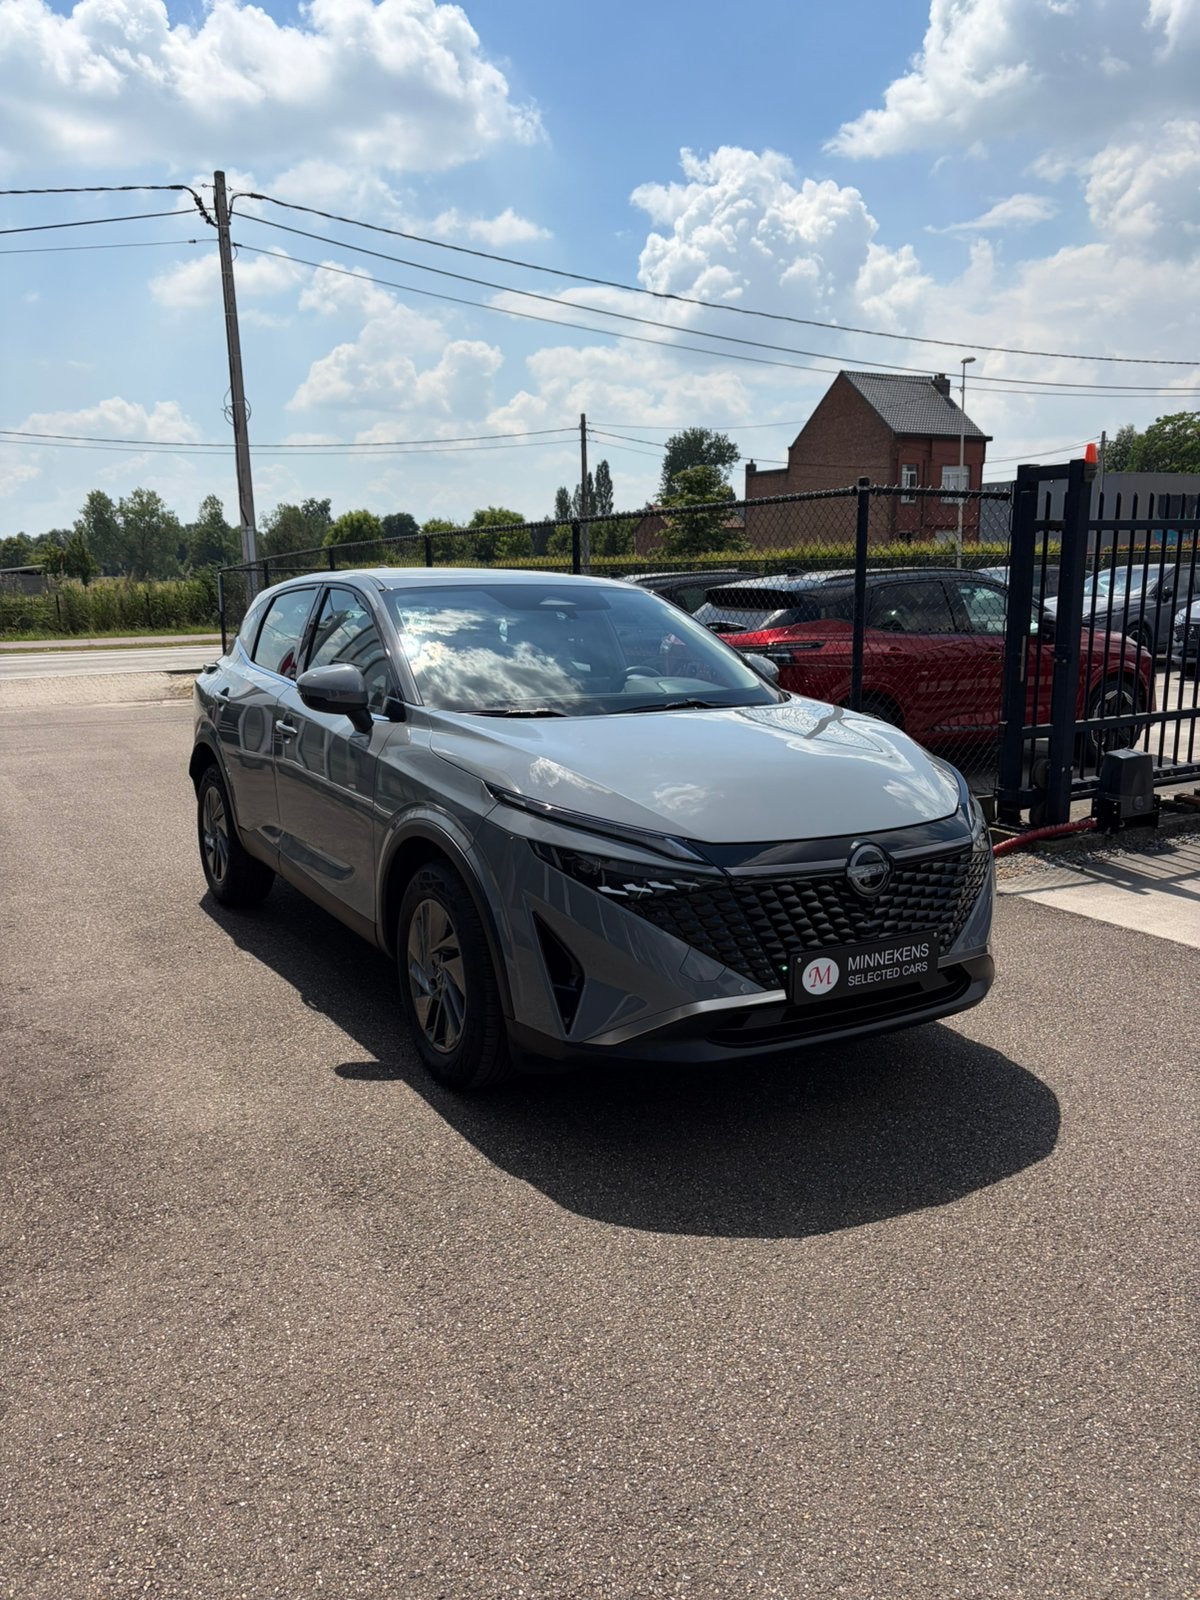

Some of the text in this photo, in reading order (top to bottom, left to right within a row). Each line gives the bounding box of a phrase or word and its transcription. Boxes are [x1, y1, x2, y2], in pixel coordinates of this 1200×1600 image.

[847, 943, 929, 972] MINNEKENS
[808, 964, 832, 988] M
[847, 961, 928, 987] SELECTED CARS
